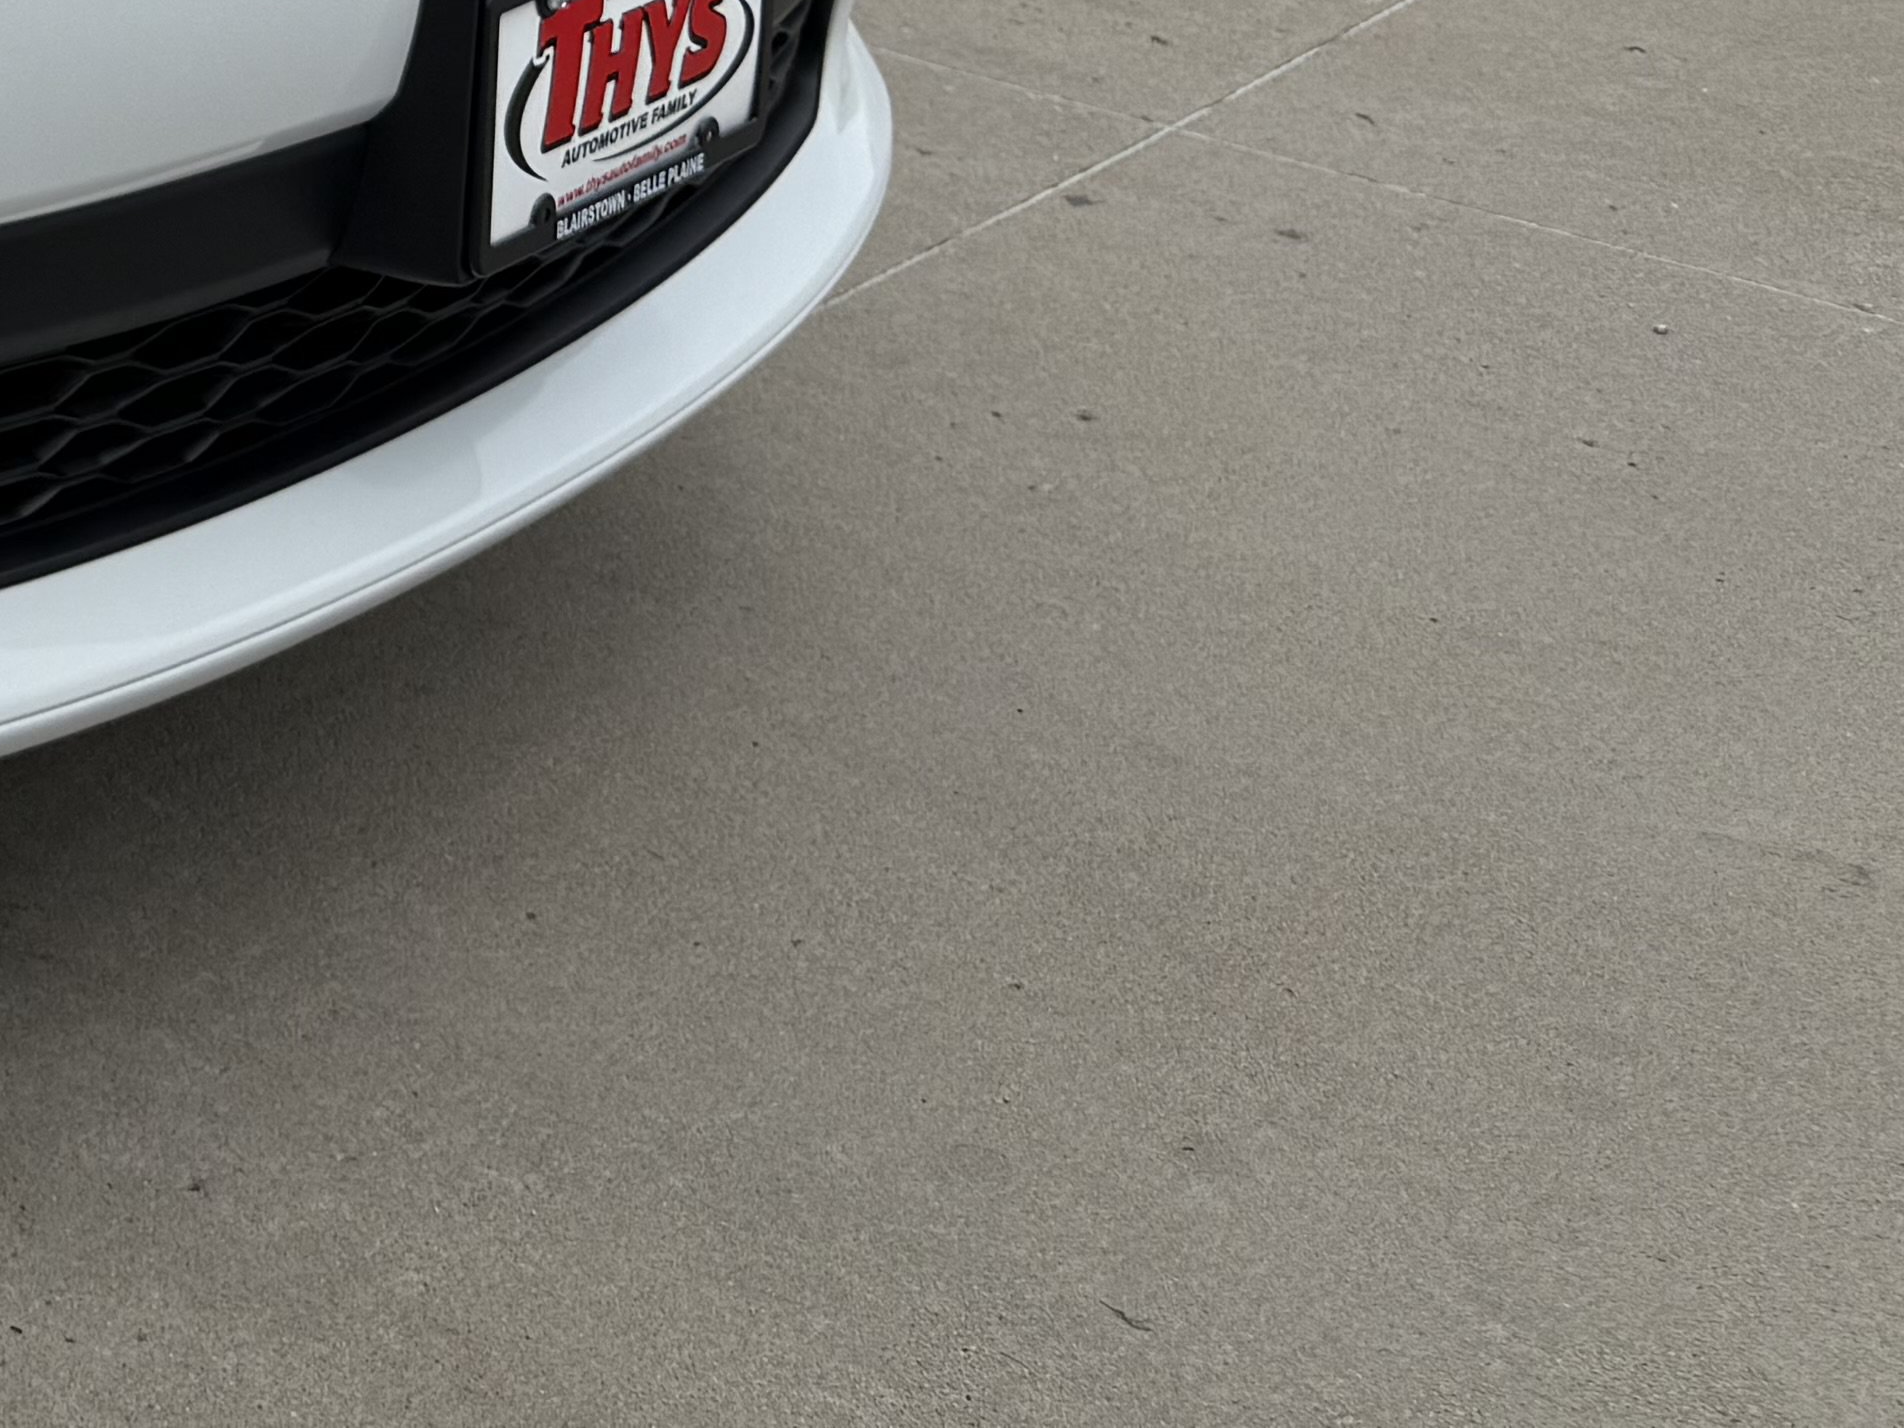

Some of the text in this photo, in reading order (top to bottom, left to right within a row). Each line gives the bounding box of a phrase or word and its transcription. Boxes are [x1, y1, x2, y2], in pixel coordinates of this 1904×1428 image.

[561, 88, 698, 169] AUTOMOTIVE FAMILY
[556, 152, 705, 240] BLAIRSTOWN BELLE PLAINE
